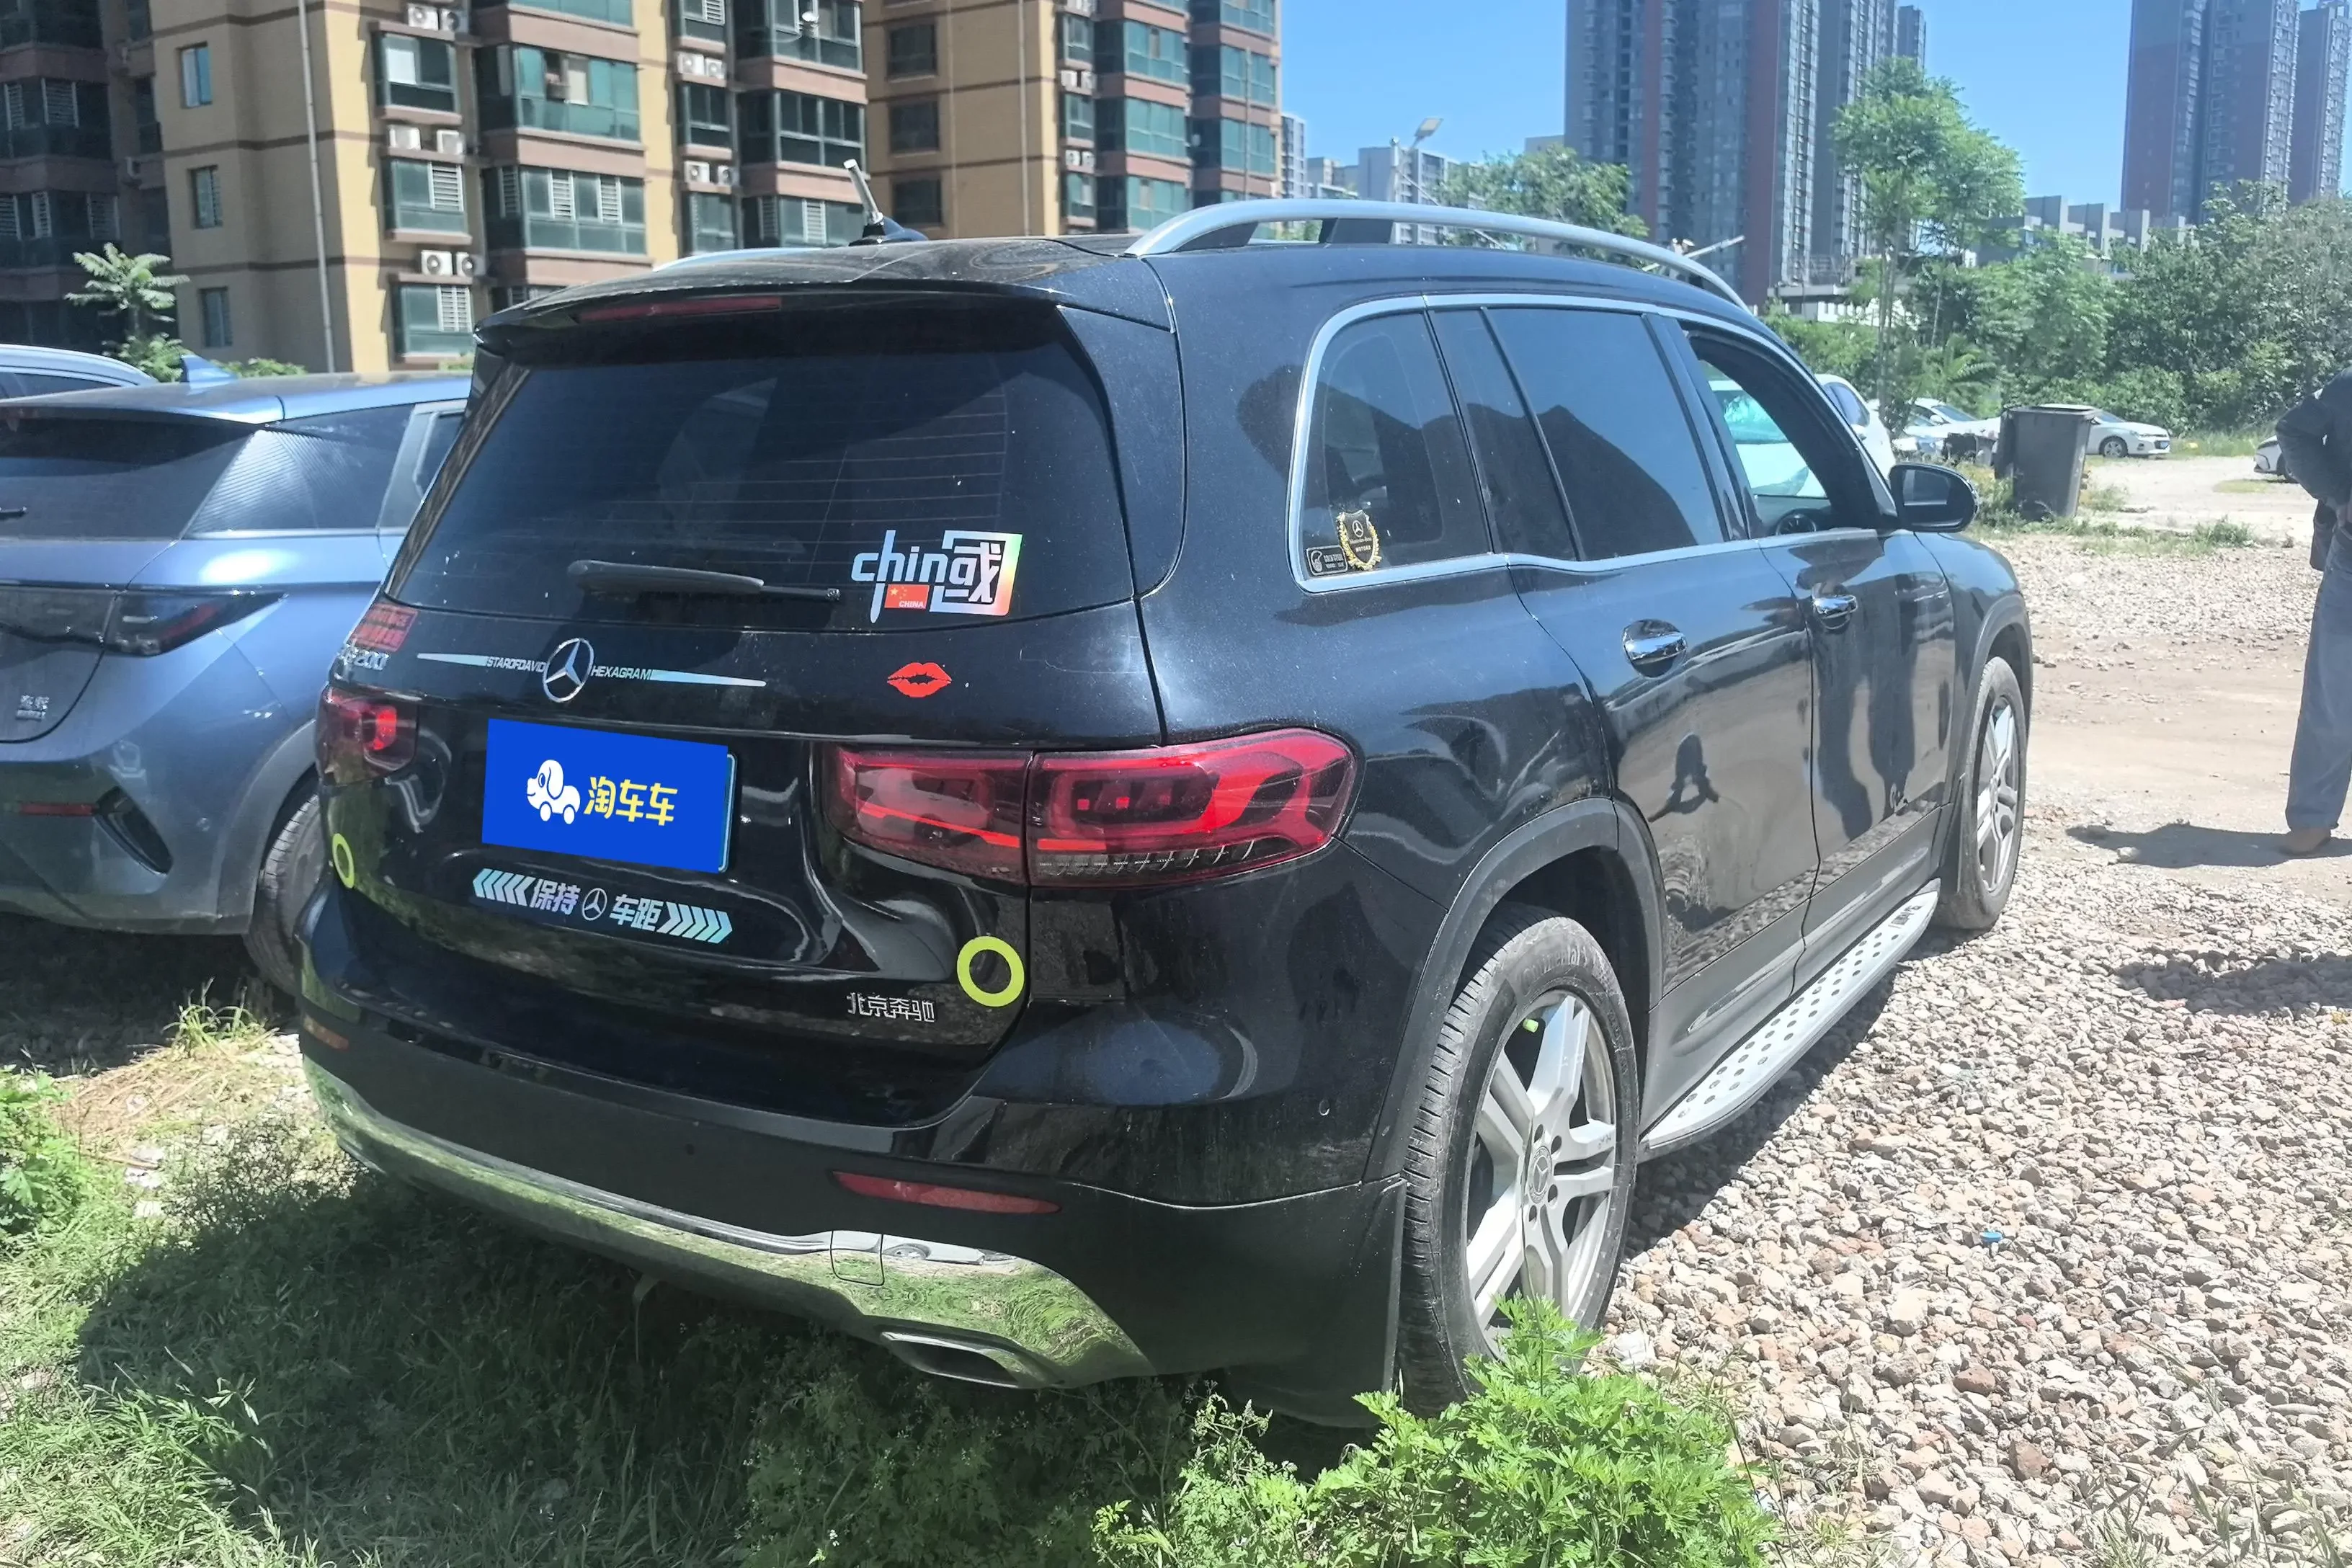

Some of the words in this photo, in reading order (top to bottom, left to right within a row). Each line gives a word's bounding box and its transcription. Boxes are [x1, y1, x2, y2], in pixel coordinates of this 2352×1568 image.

[899, 600, 926, 609] CHINA
[591, 665, 652, 681] HEXAGRAM
[530, 878, 582, 915] 保持
[609, 894, 664, 932] 车距
[846, 992, 935, 1023] 北京奔驰
